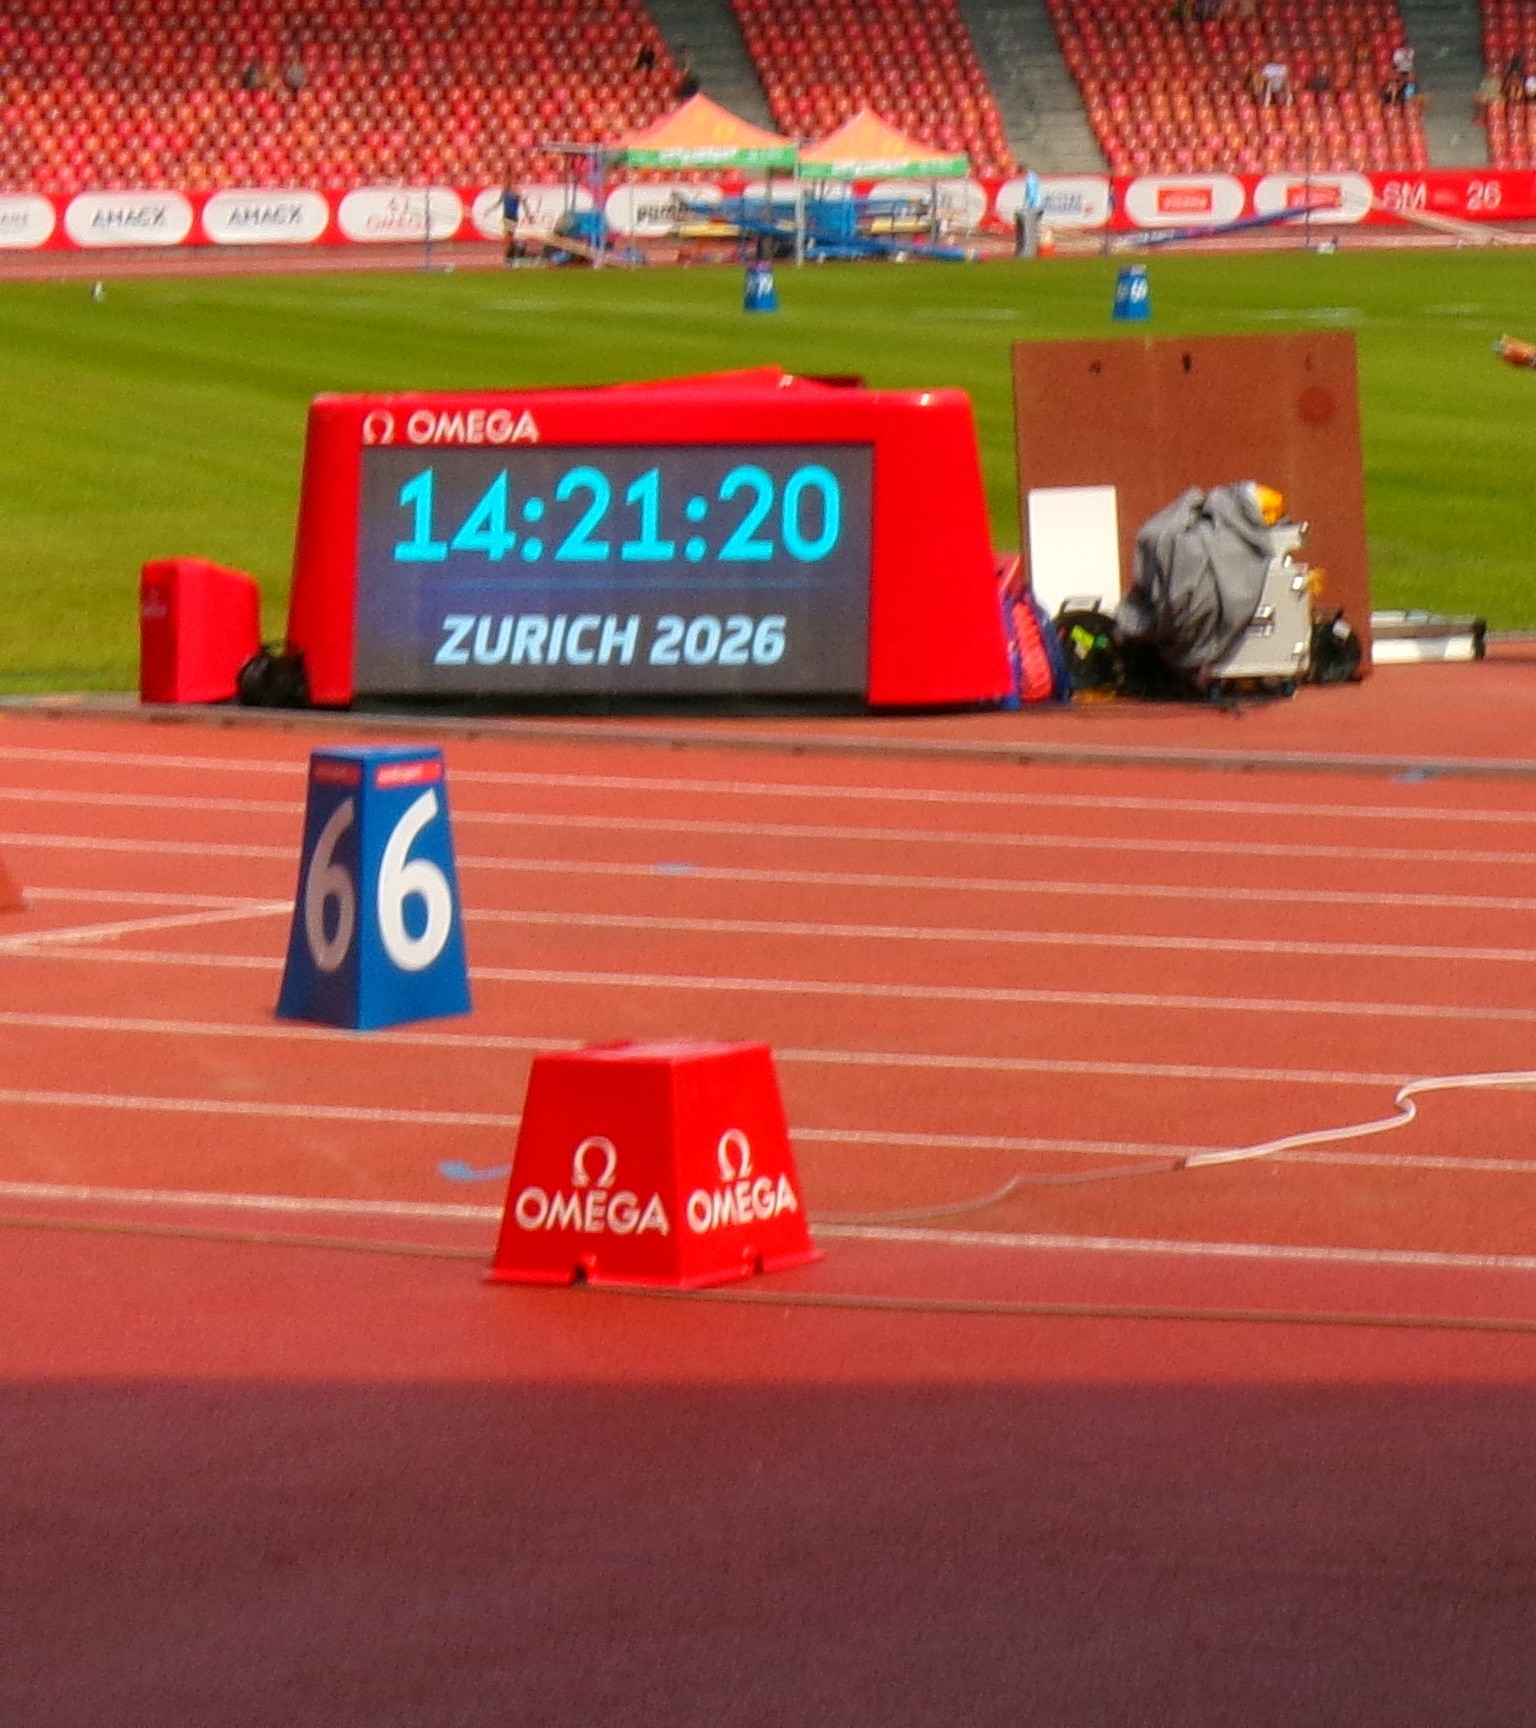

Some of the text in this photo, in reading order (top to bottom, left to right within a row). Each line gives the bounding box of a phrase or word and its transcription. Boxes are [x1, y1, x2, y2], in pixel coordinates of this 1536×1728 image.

[407, 408, 540, 444] OMEGA
[394, 465, 841, 562] 14:21:20
[434, 615, 787, 665] ZURICH 2026
[304, 796, 354, 972] 6
[377, 788, 452, 971] 6
[514, 1186, 670, 1237] OMEGA
[686, 1174, 797, 1232] OMEGA
